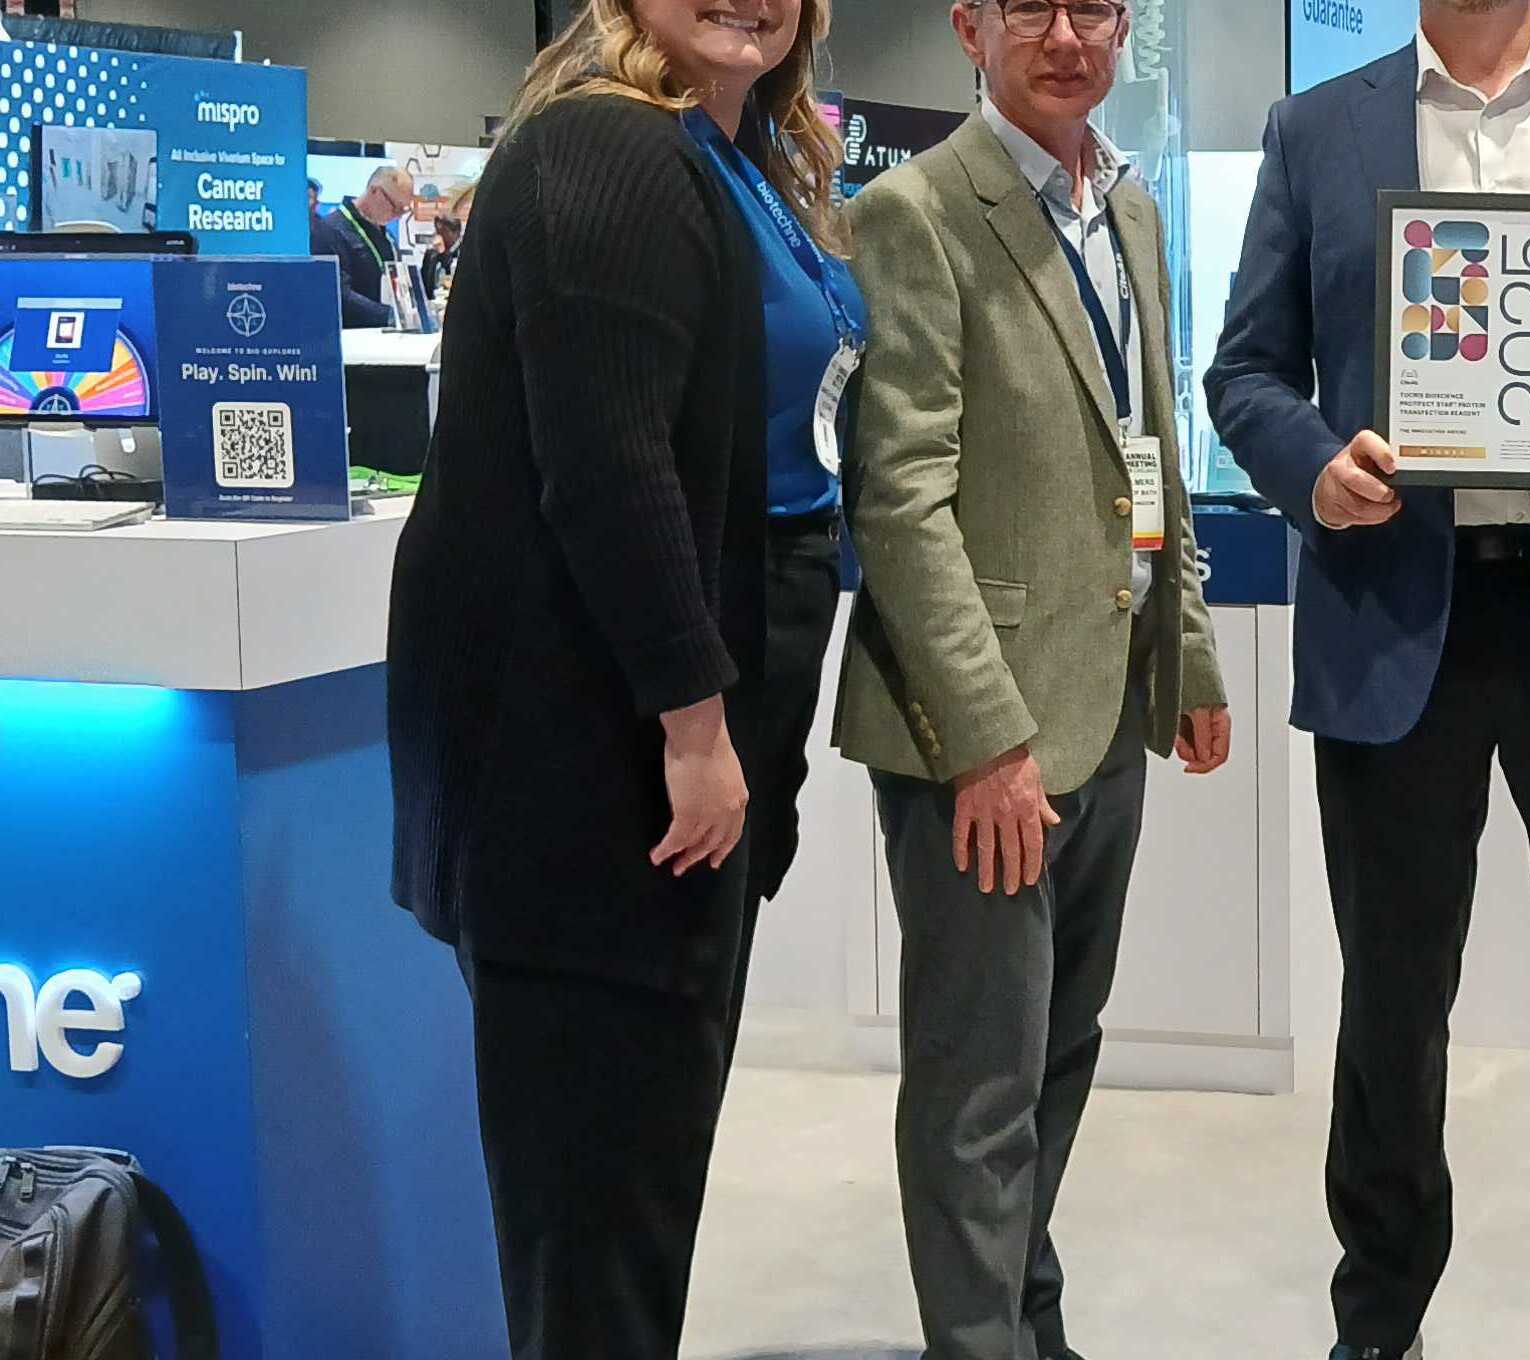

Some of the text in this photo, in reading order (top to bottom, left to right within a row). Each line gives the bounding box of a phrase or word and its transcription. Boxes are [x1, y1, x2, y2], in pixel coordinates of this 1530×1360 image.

[197, 101, 260, 132] mispro
[197, 172, 264, 200] Cancer
[188, 203, 273, 231] Research
[757, 180, 801, 248] biotechne
[181, 363, 317, 385] Play. Spin. Win!
